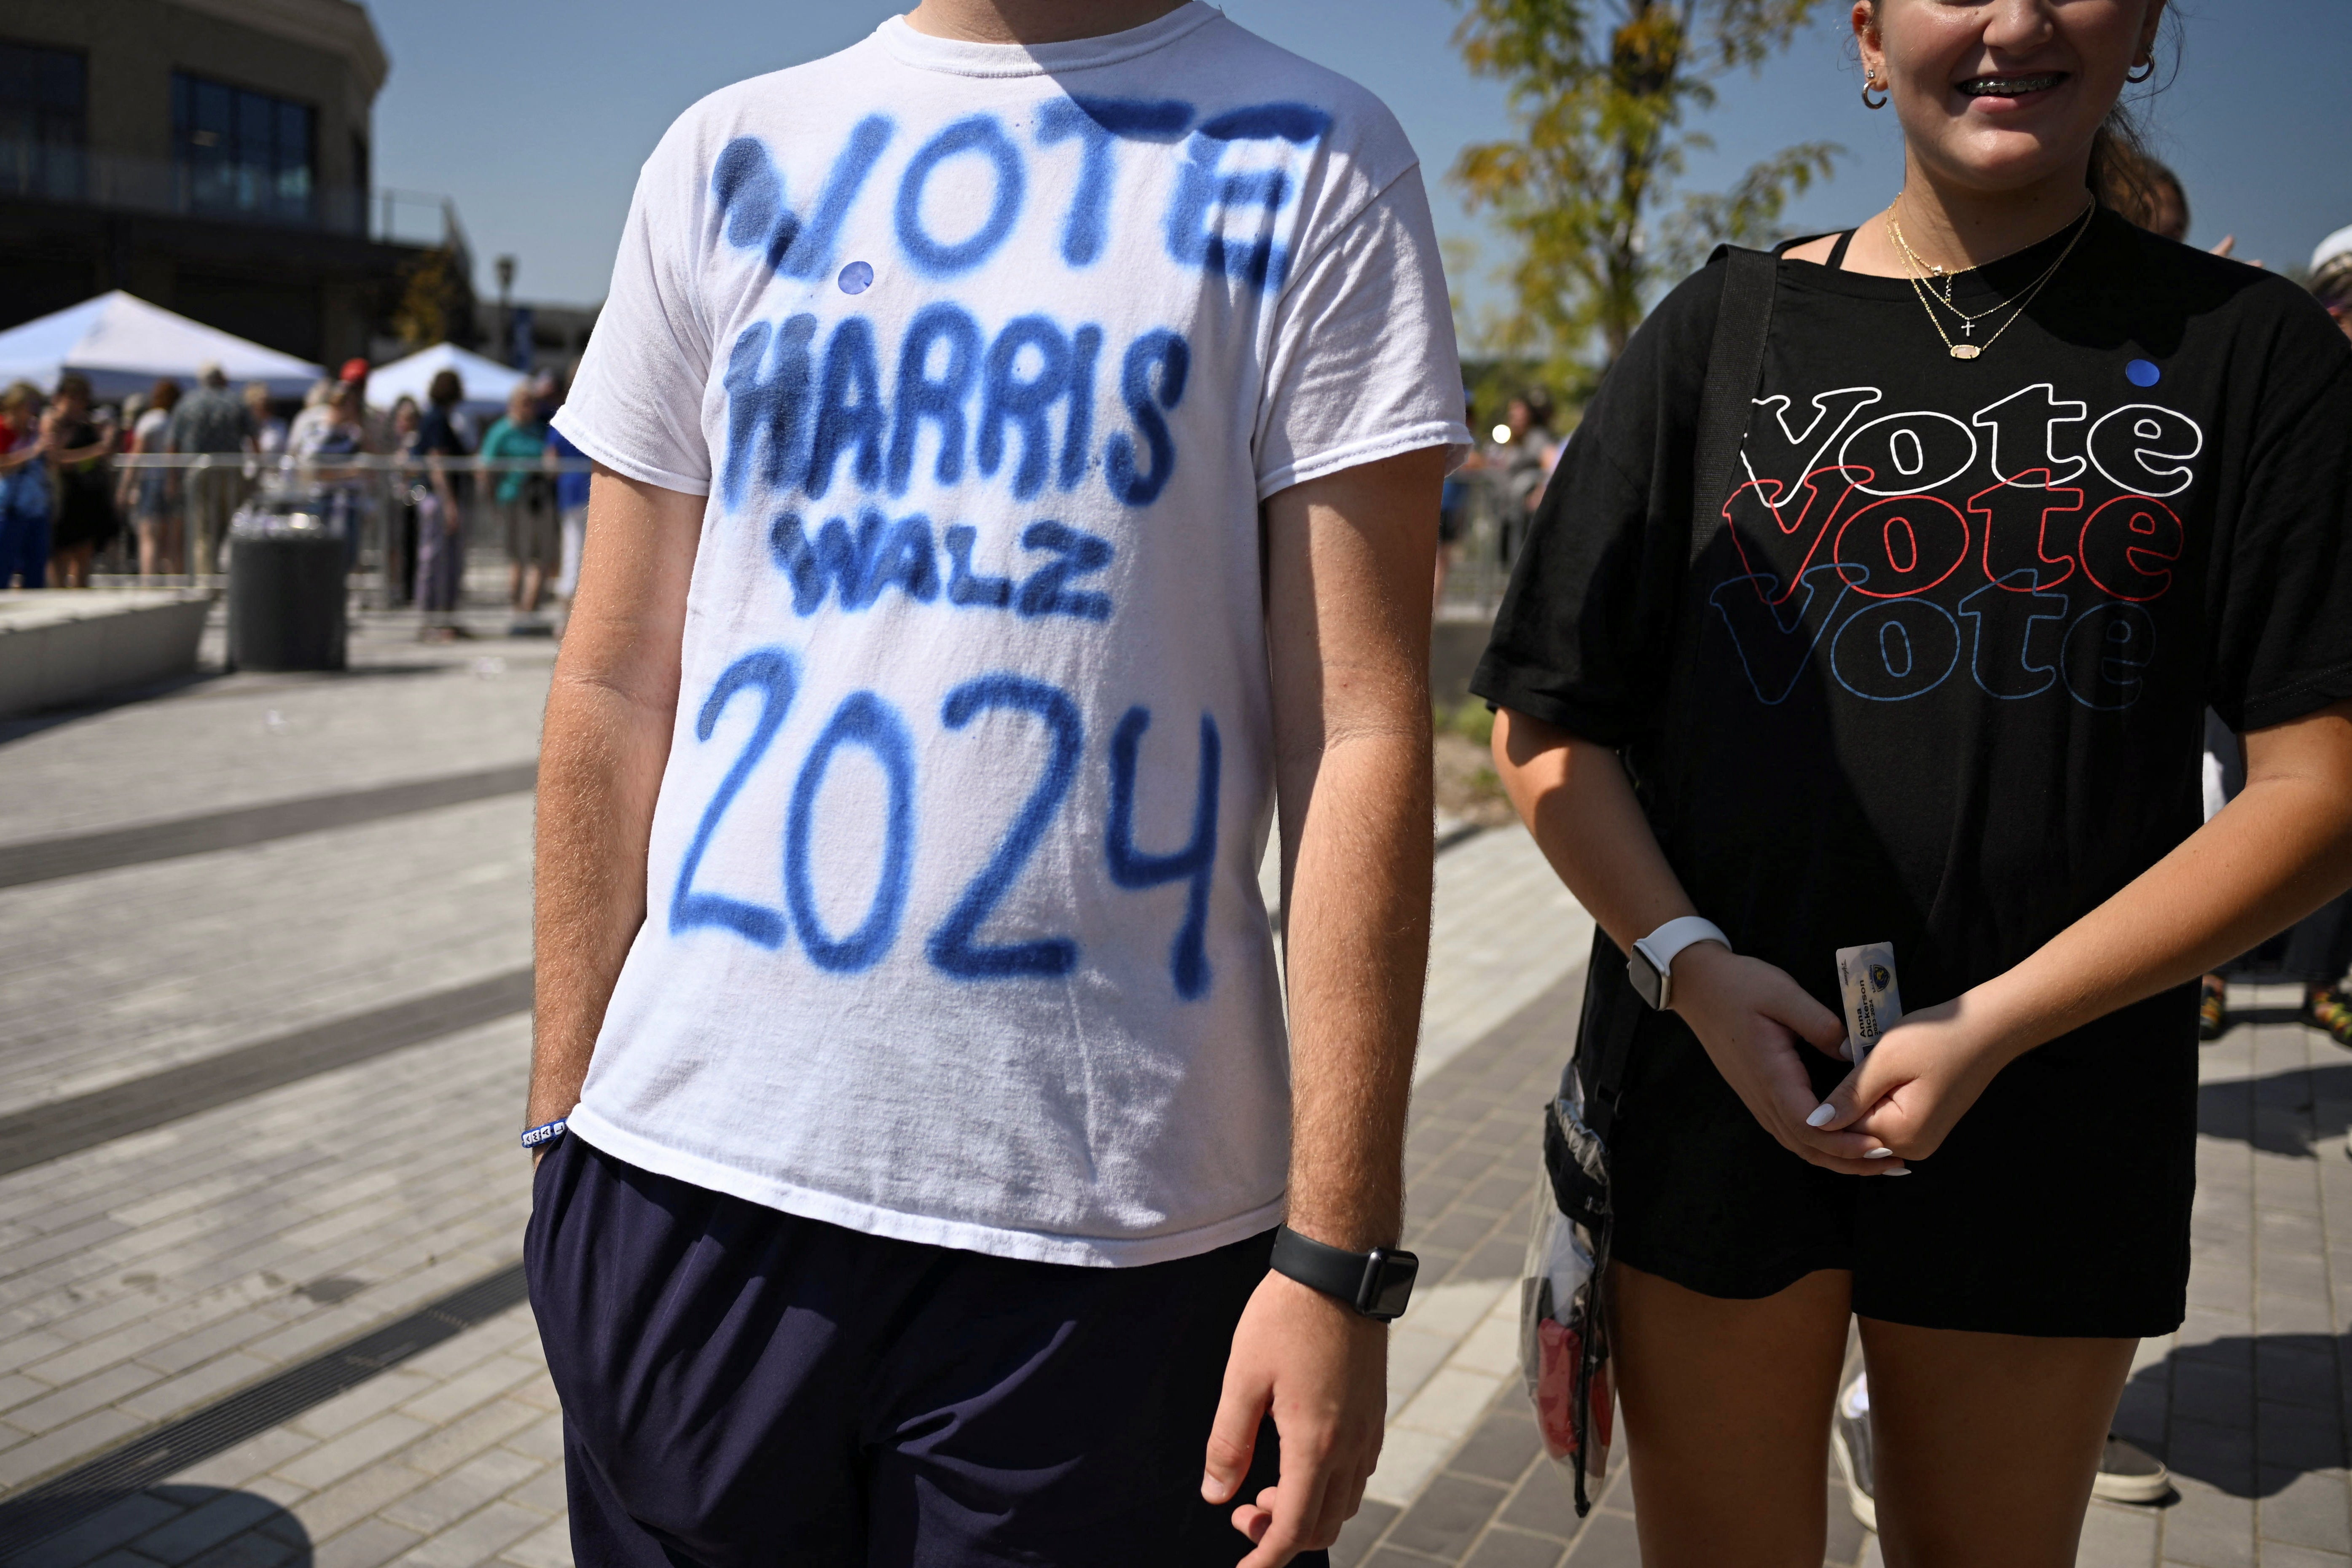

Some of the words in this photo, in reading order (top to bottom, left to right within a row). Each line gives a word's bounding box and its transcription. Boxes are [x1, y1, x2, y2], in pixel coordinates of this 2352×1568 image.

[712, 98, 1332, 292] VOTE
[722, 300, 1191, 511] HARRIS
[1741, 383, 2203, 508] Vote
[768, 504, 1115, 620] WALZ
[1721, 464, 2184, 605] Vote
[1709, 562, 2156, 710] Vote
[670, 644, 1222, 1001] 2024
[1857, 1008, 1866, 1038] Anna
[1860, 980, 1873, 1037] Dickerson
[1869, 999, 1879, 1036] 2023-2024
[526, 1125, 564, 1142] AMAL
